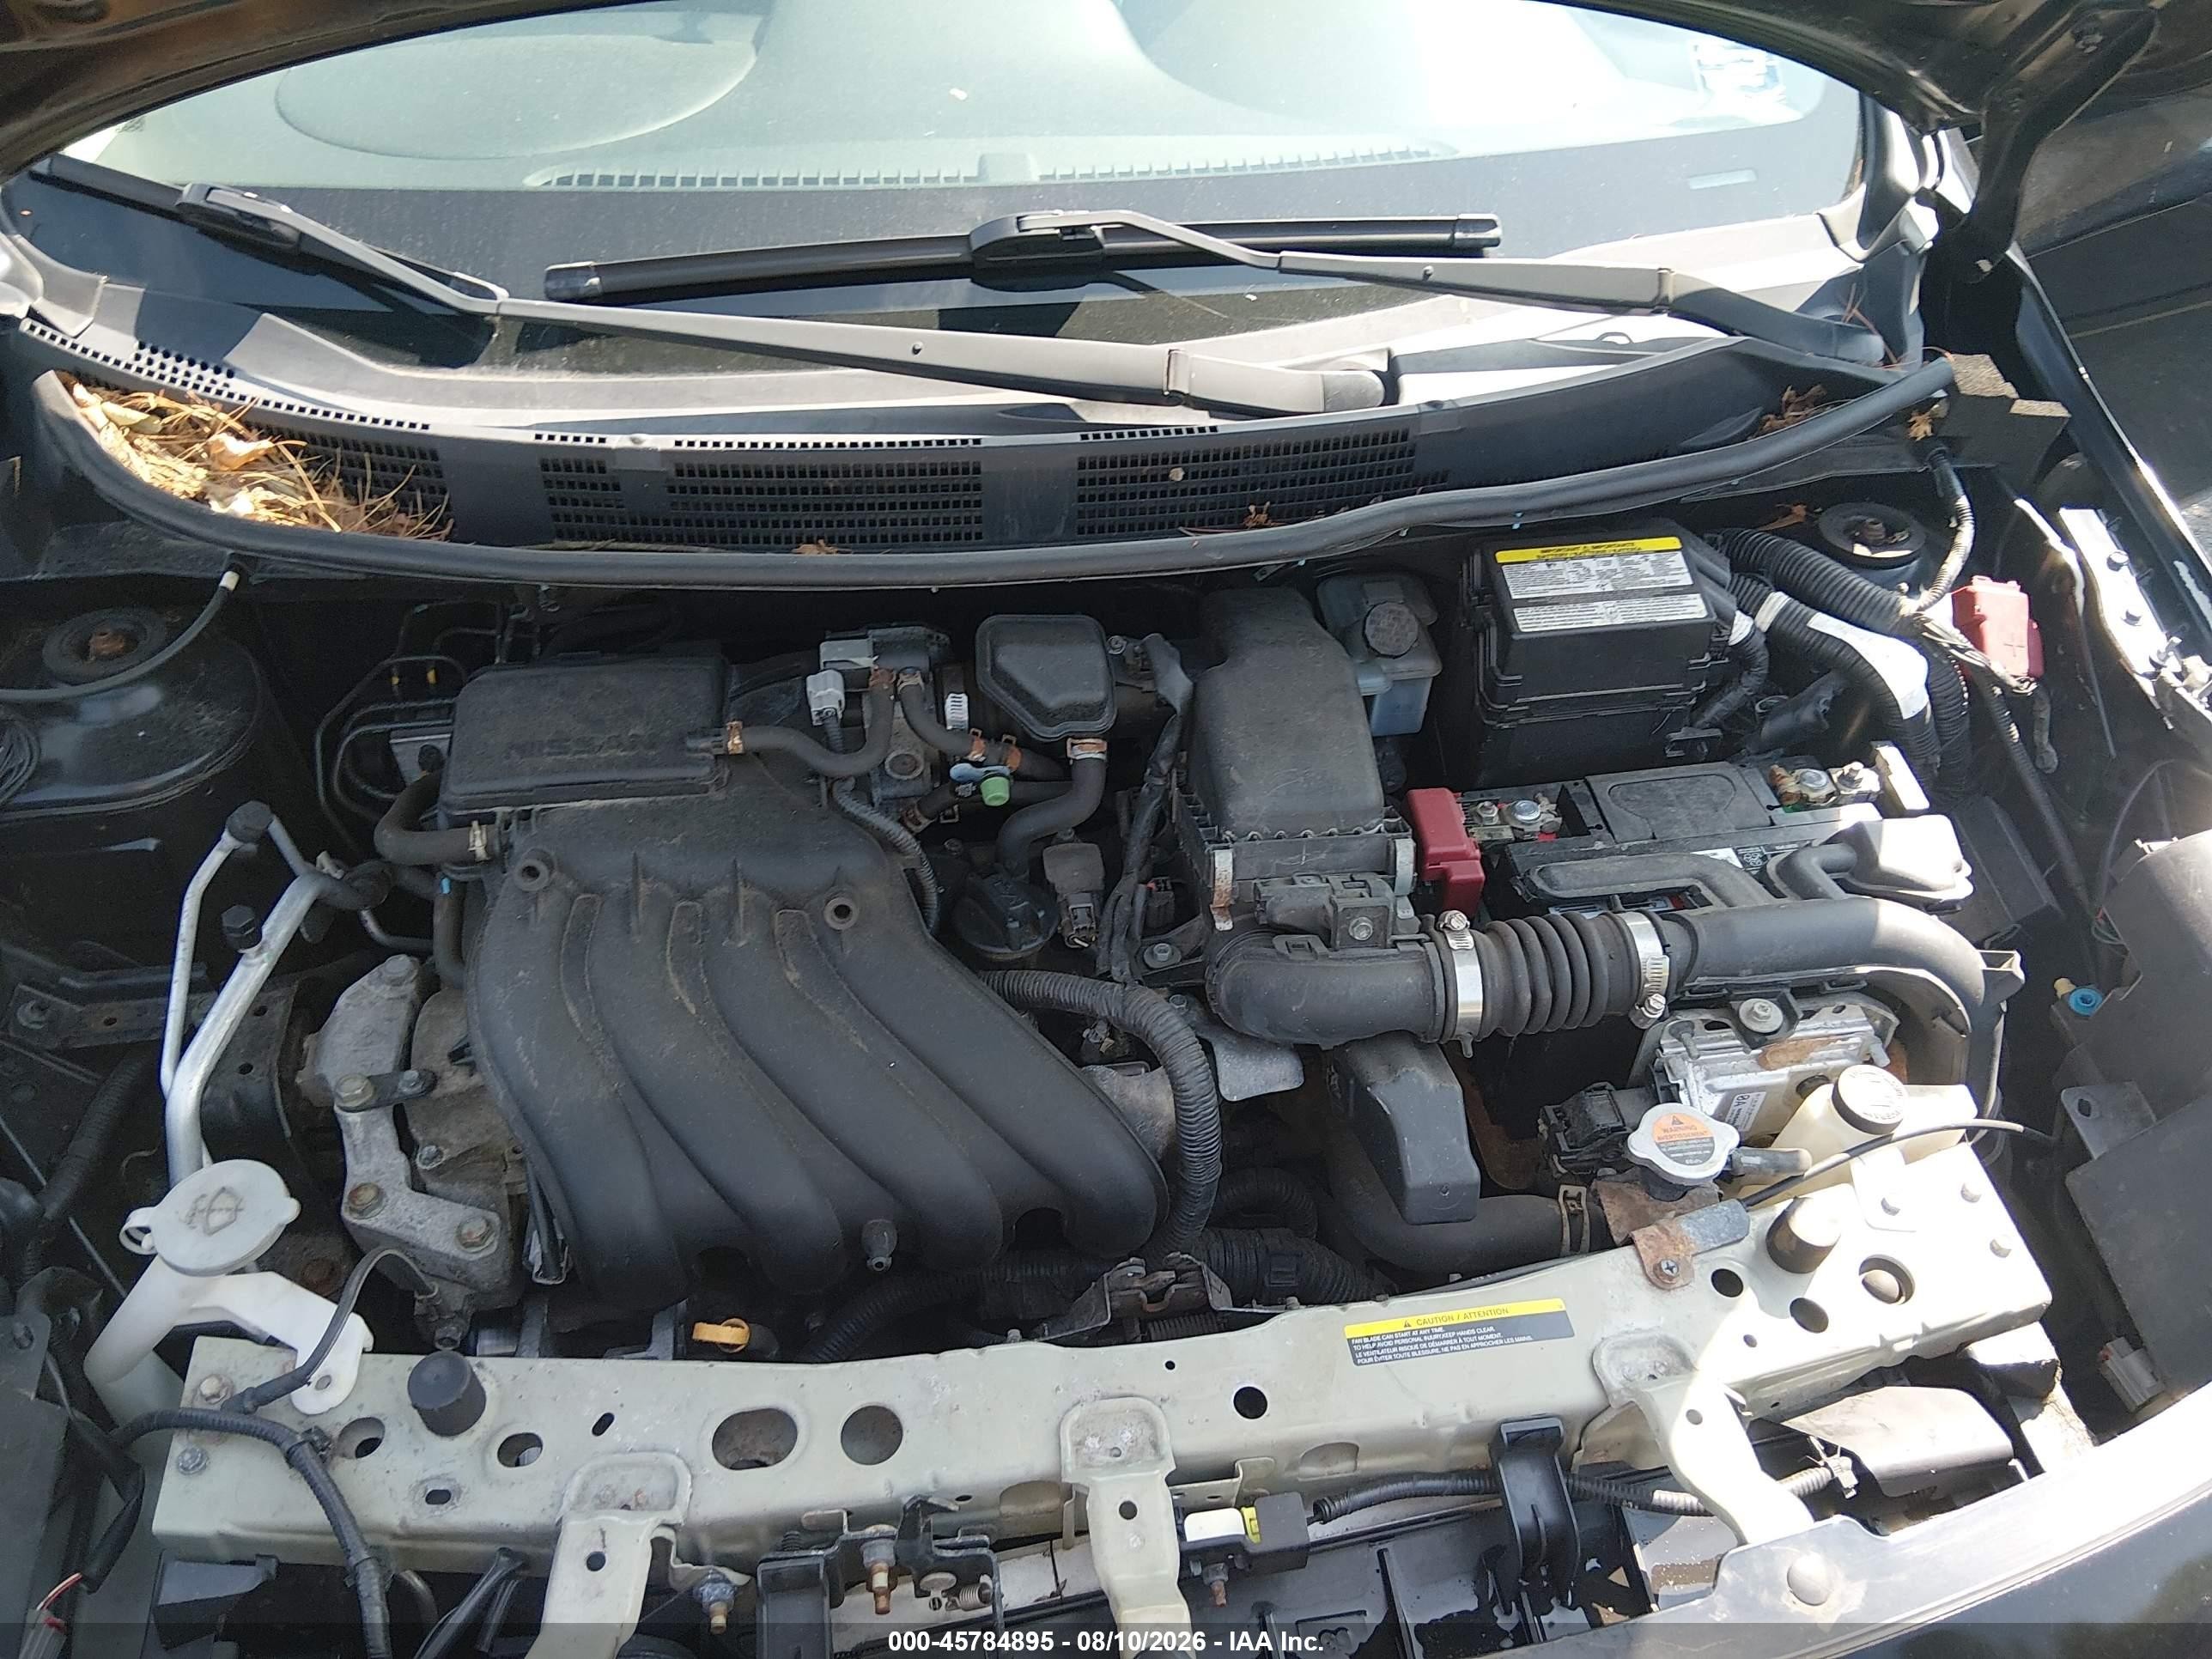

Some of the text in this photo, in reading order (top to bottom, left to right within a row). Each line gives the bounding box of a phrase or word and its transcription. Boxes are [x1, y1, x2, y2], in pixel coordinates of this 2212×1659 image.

[1416, 1316, 1454, 1326] CAUTION
[1463, 1308, 1509, 1320] ATTENTION
[1395, 1336, 1422, 1345] PERSONAL
[1470, 1340, 1504, 1348] APPROCHER
[1363, 1347, 1398, 1358] VENTILATEUR
[1428, 1337, 1458, 1348] DÉMARRER
